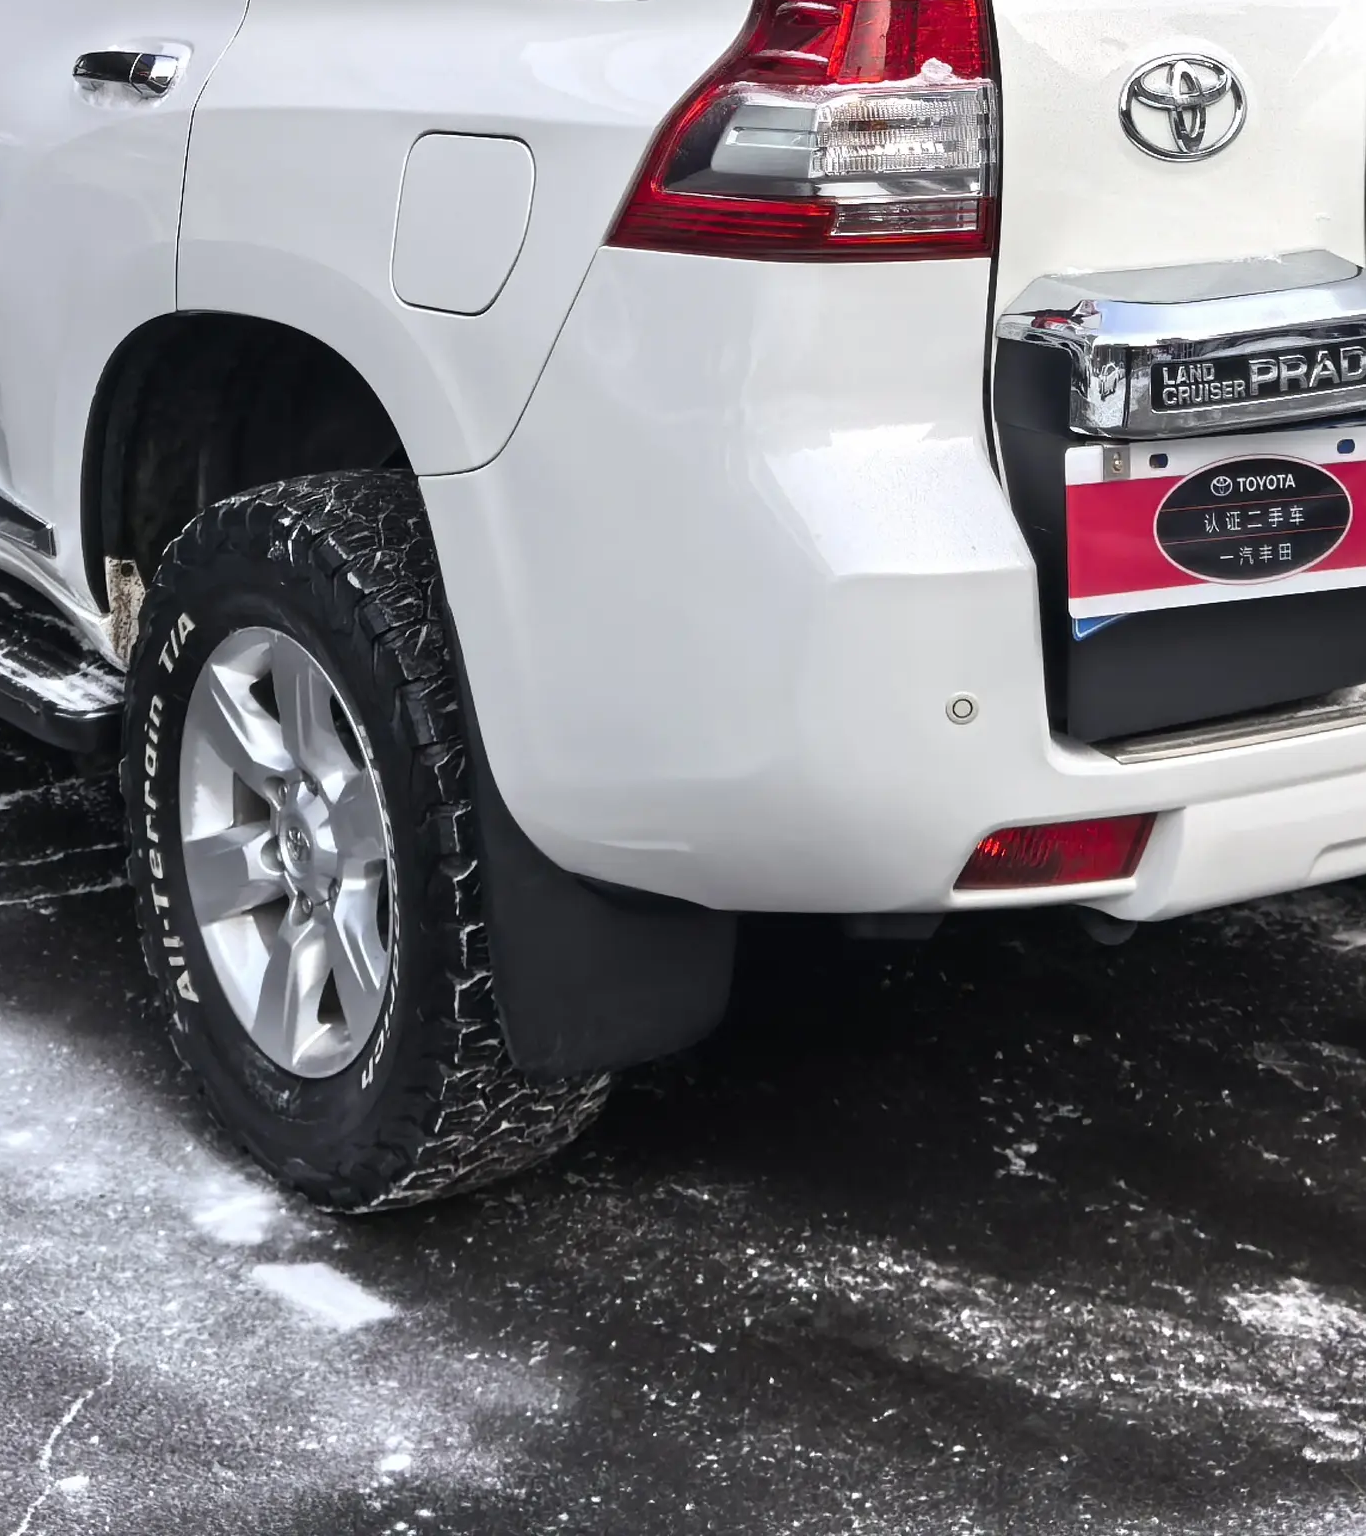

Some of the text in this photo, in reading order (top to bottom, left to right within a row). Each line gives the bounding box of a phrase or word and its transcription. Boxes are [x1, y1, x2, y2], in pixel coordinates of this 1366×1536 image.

[1162, 363, 1216, 386] LAND
[1161, 379, 1246, 406] CRUISER
[1237, 473, 1296, 493] TOYOTA
[1204, 505, 1305, 534] 认证二手车
[1219, 542, 1292, 566] 一汽丰田
[144, 612, 200, 1003] All-Terrain T/A
